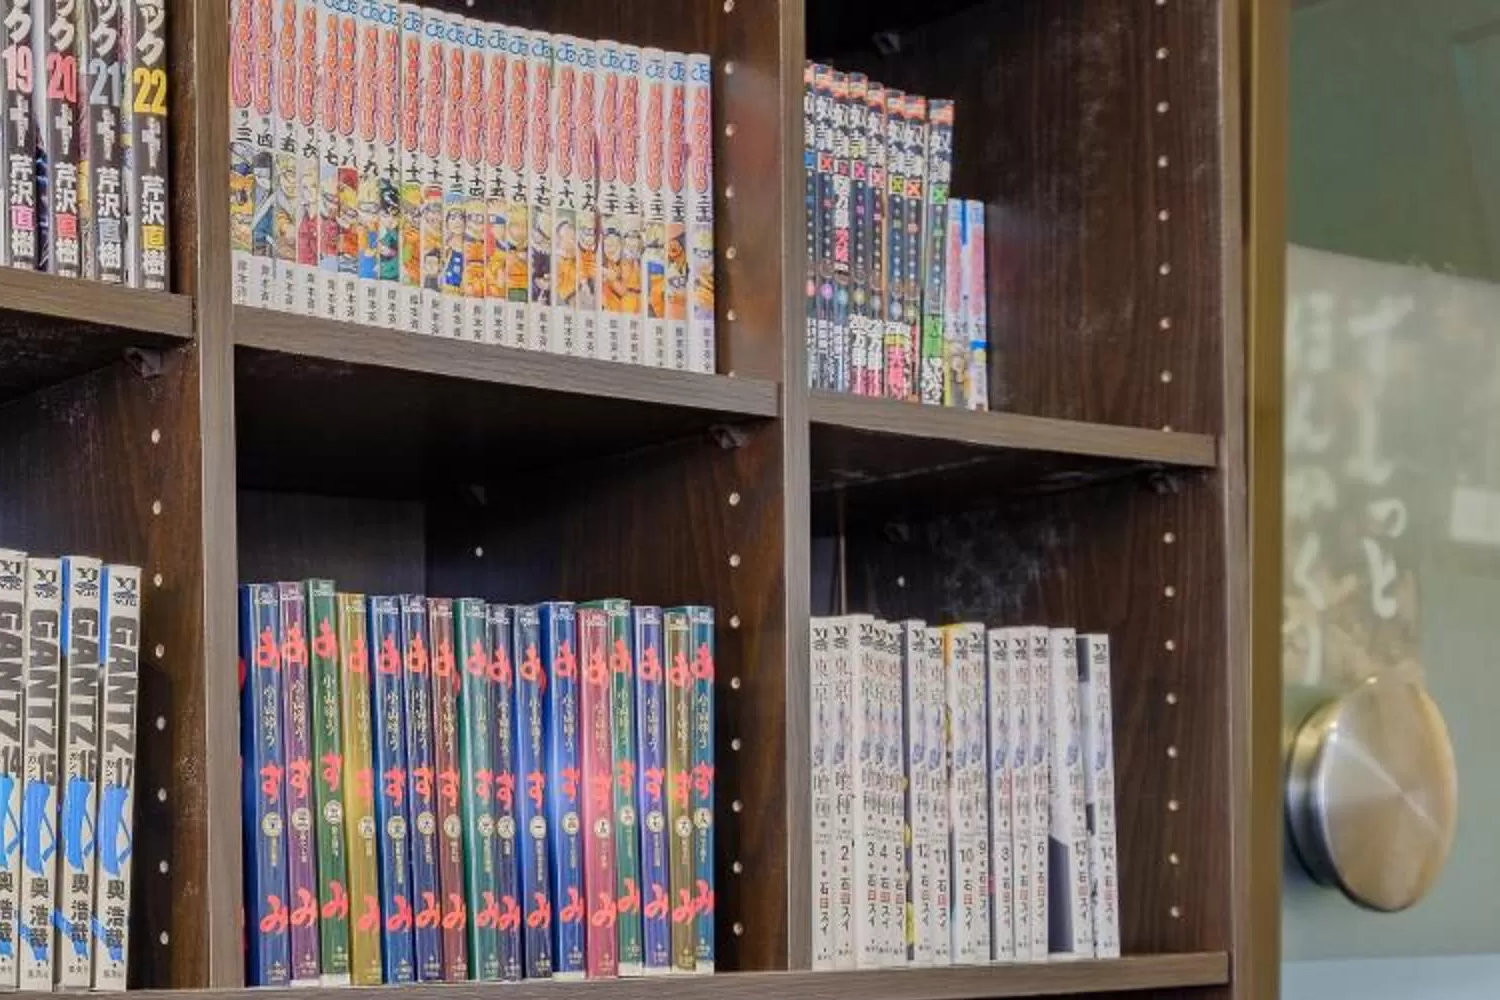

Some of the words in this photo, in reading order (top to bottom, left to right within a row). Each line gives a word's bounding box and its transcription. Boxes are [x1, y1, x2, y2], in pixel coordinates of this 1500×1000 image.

[3, 46, 33, 92] 19
[47, 55, 77, 103] 20
[90, 62, 121, 105] 21
[133, 68, 167, 116] 22
[28, 609, 59, 751] GANTZ
[70, 607, 99, 748] GANTZ
[106, 616, 137, 754] GANTZ
